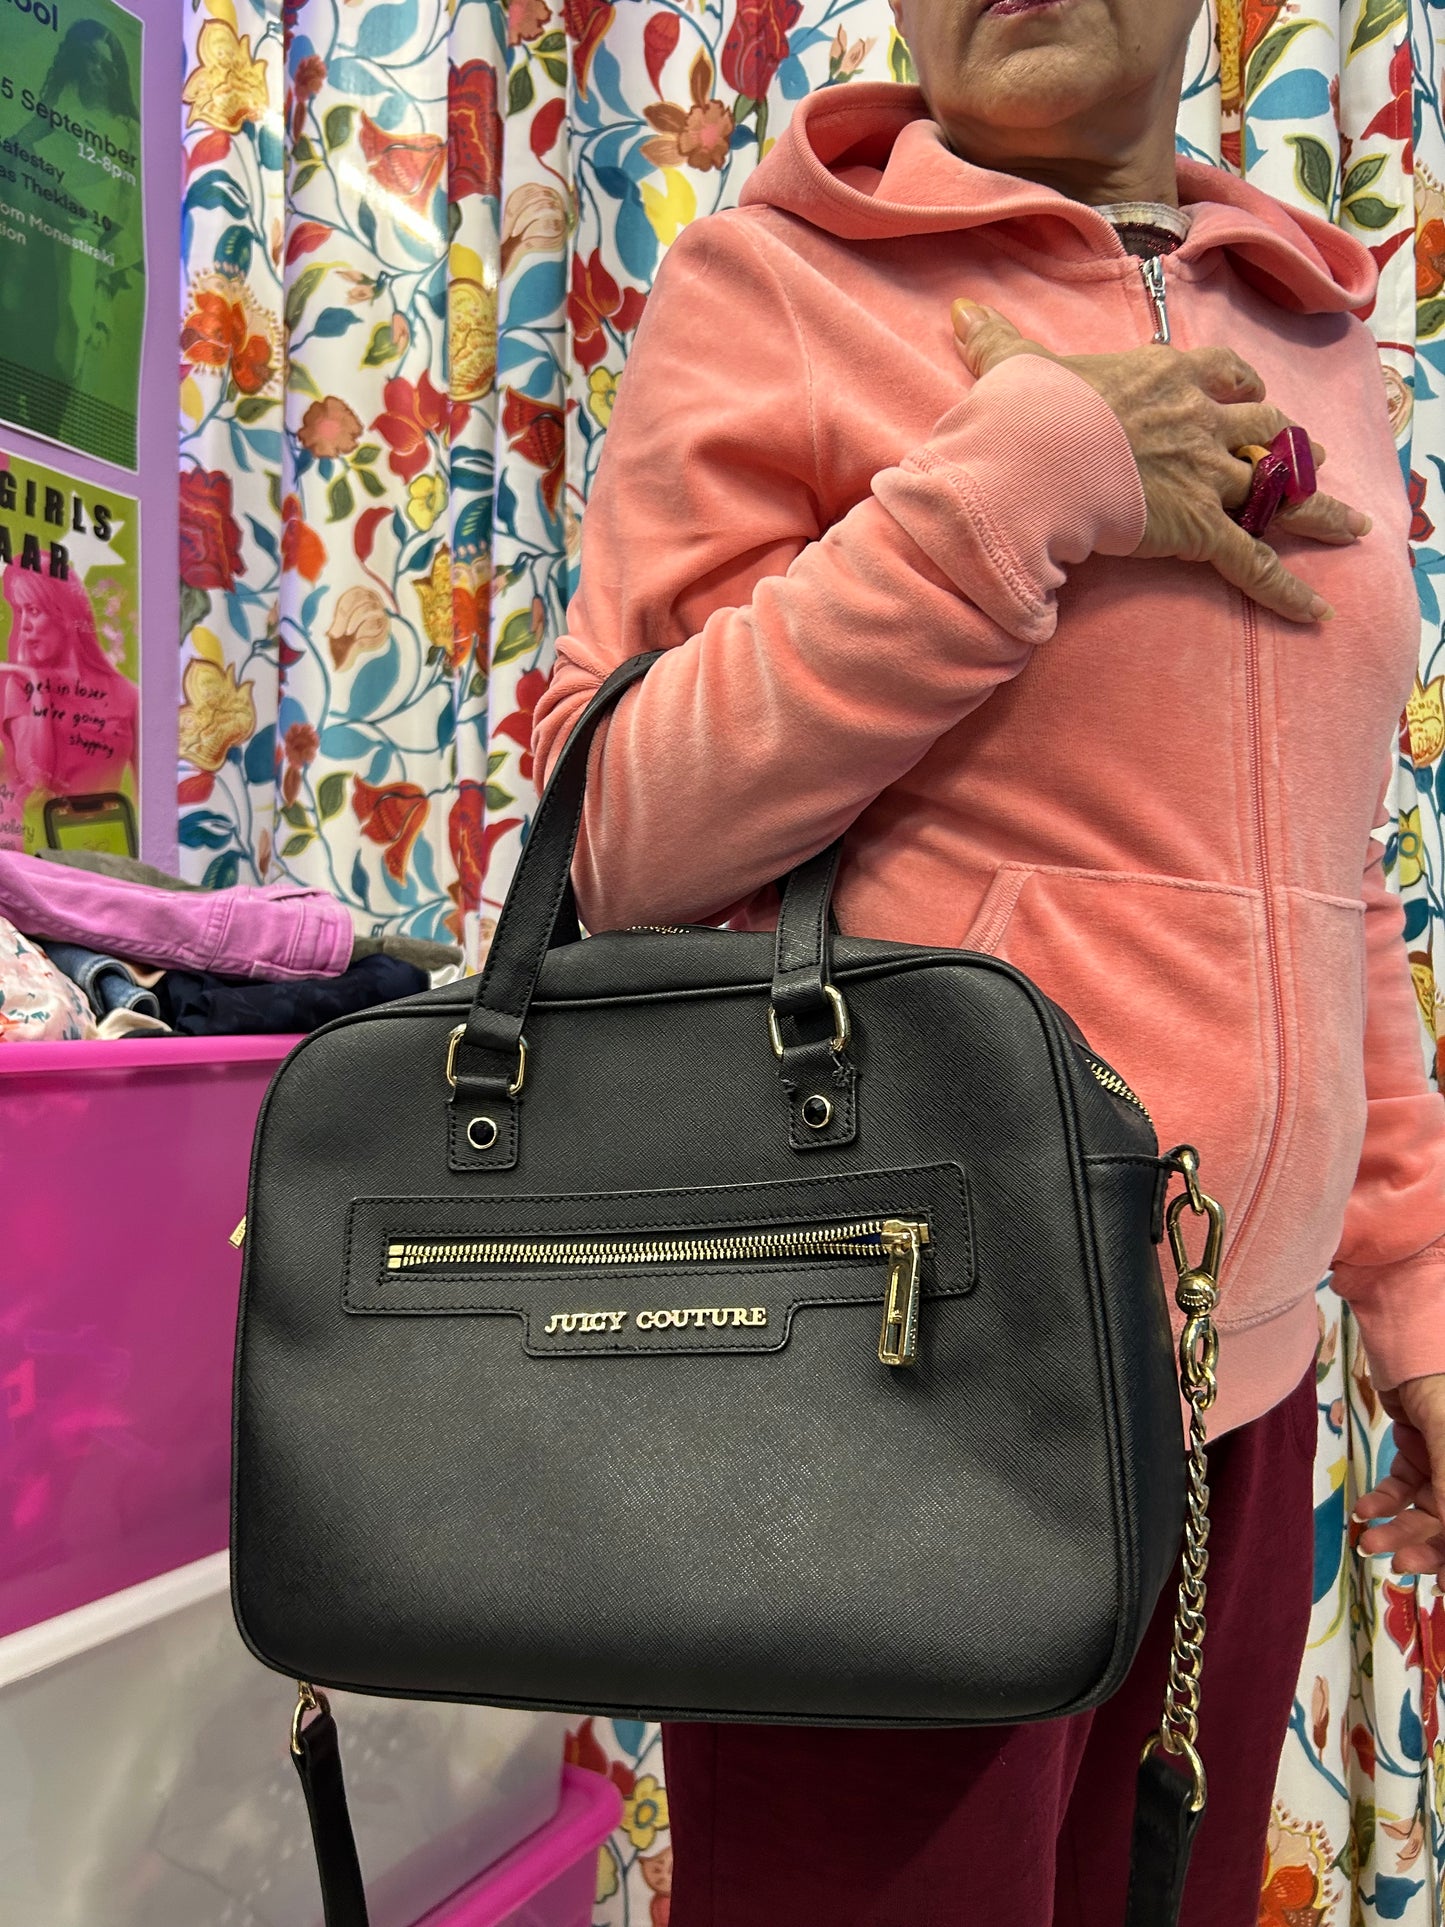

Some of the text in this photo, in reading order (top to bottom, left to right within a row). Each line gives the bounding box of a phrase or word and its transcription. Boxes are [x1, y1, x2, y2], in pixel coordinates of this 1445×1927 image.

[6, 0, 58, 32] ool
[1, 76, 138, 168] 5 September
[0, 137, 65, 184] afestay
[78, 142, 137, 187] 12-8pm
[0, 201, 25, 223] om
[0, 470, 112, 542] GIRLS
[0, 525, 69, 581] AAR
[24, 678, 51, 702] get
[33, 702, 106, 732] we're going
[69, 734, 114, 759] shopping
[544, 1307, 768, 1335] JUICY COUTURE
